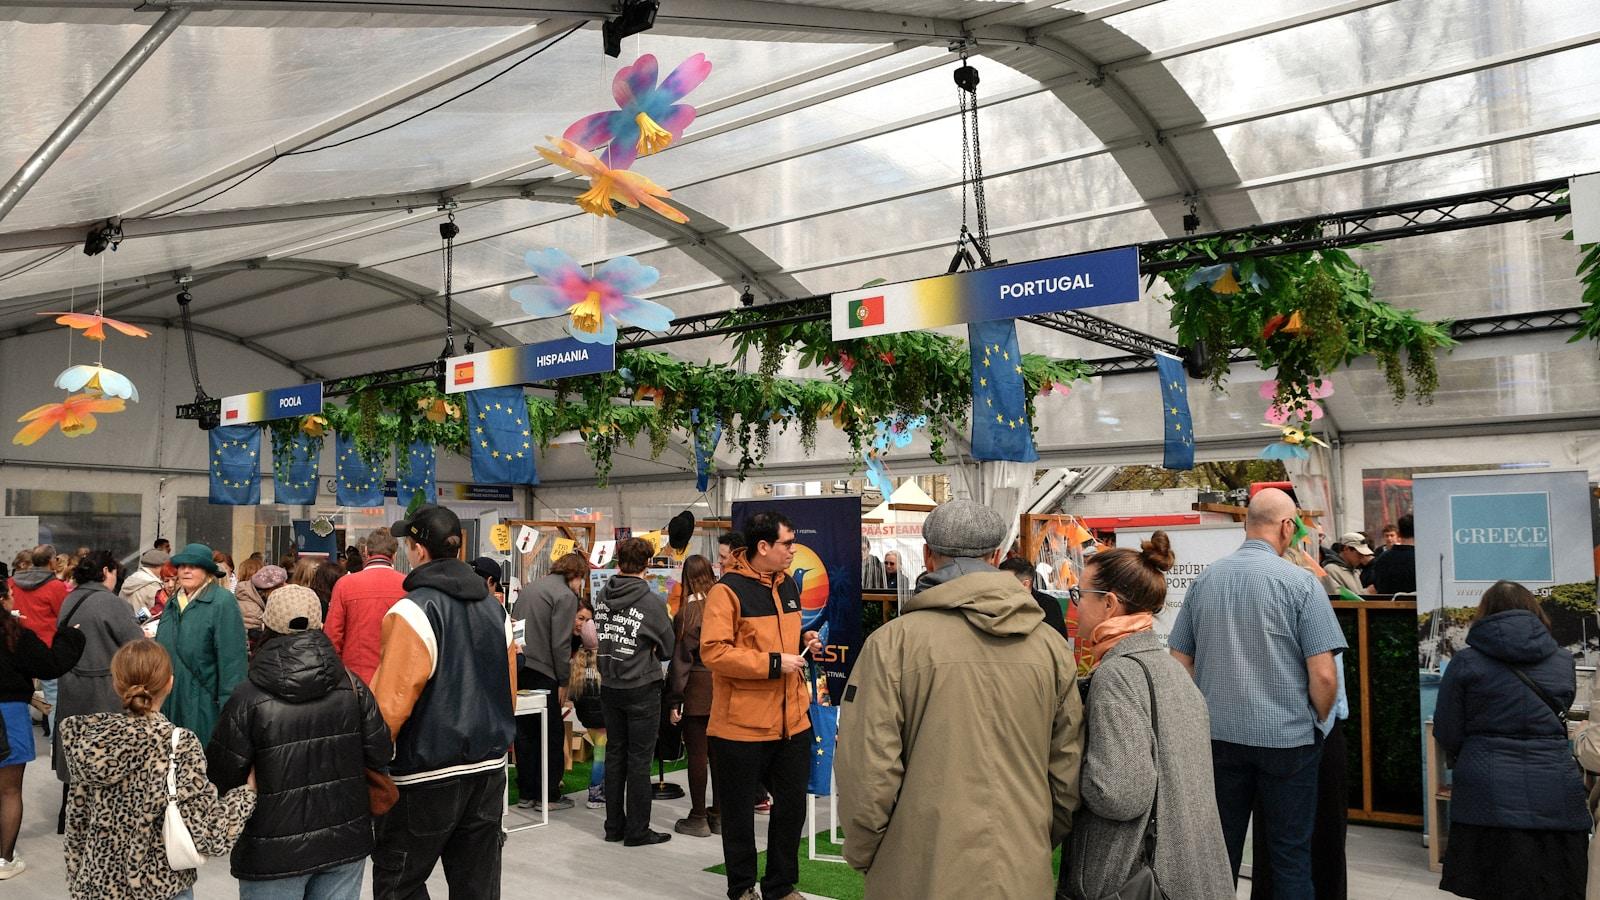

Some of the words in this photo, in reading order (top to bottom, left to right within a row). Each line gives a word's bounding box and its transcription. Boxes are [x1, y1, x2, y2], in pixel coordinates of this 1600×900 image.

[1000, 273, 1094, 300] PORTUGAL
[536, 349, 589, 368] HISPAANIA
[279, 396, 302, 408] POOLA
[1455, 526, 1548, 545] GREECE
[629, 607, 644, 620] the
[604, 622, 627, 635] game,
[612, 614, 641, 630] slaying
[619, 636, 638, 647] real.
